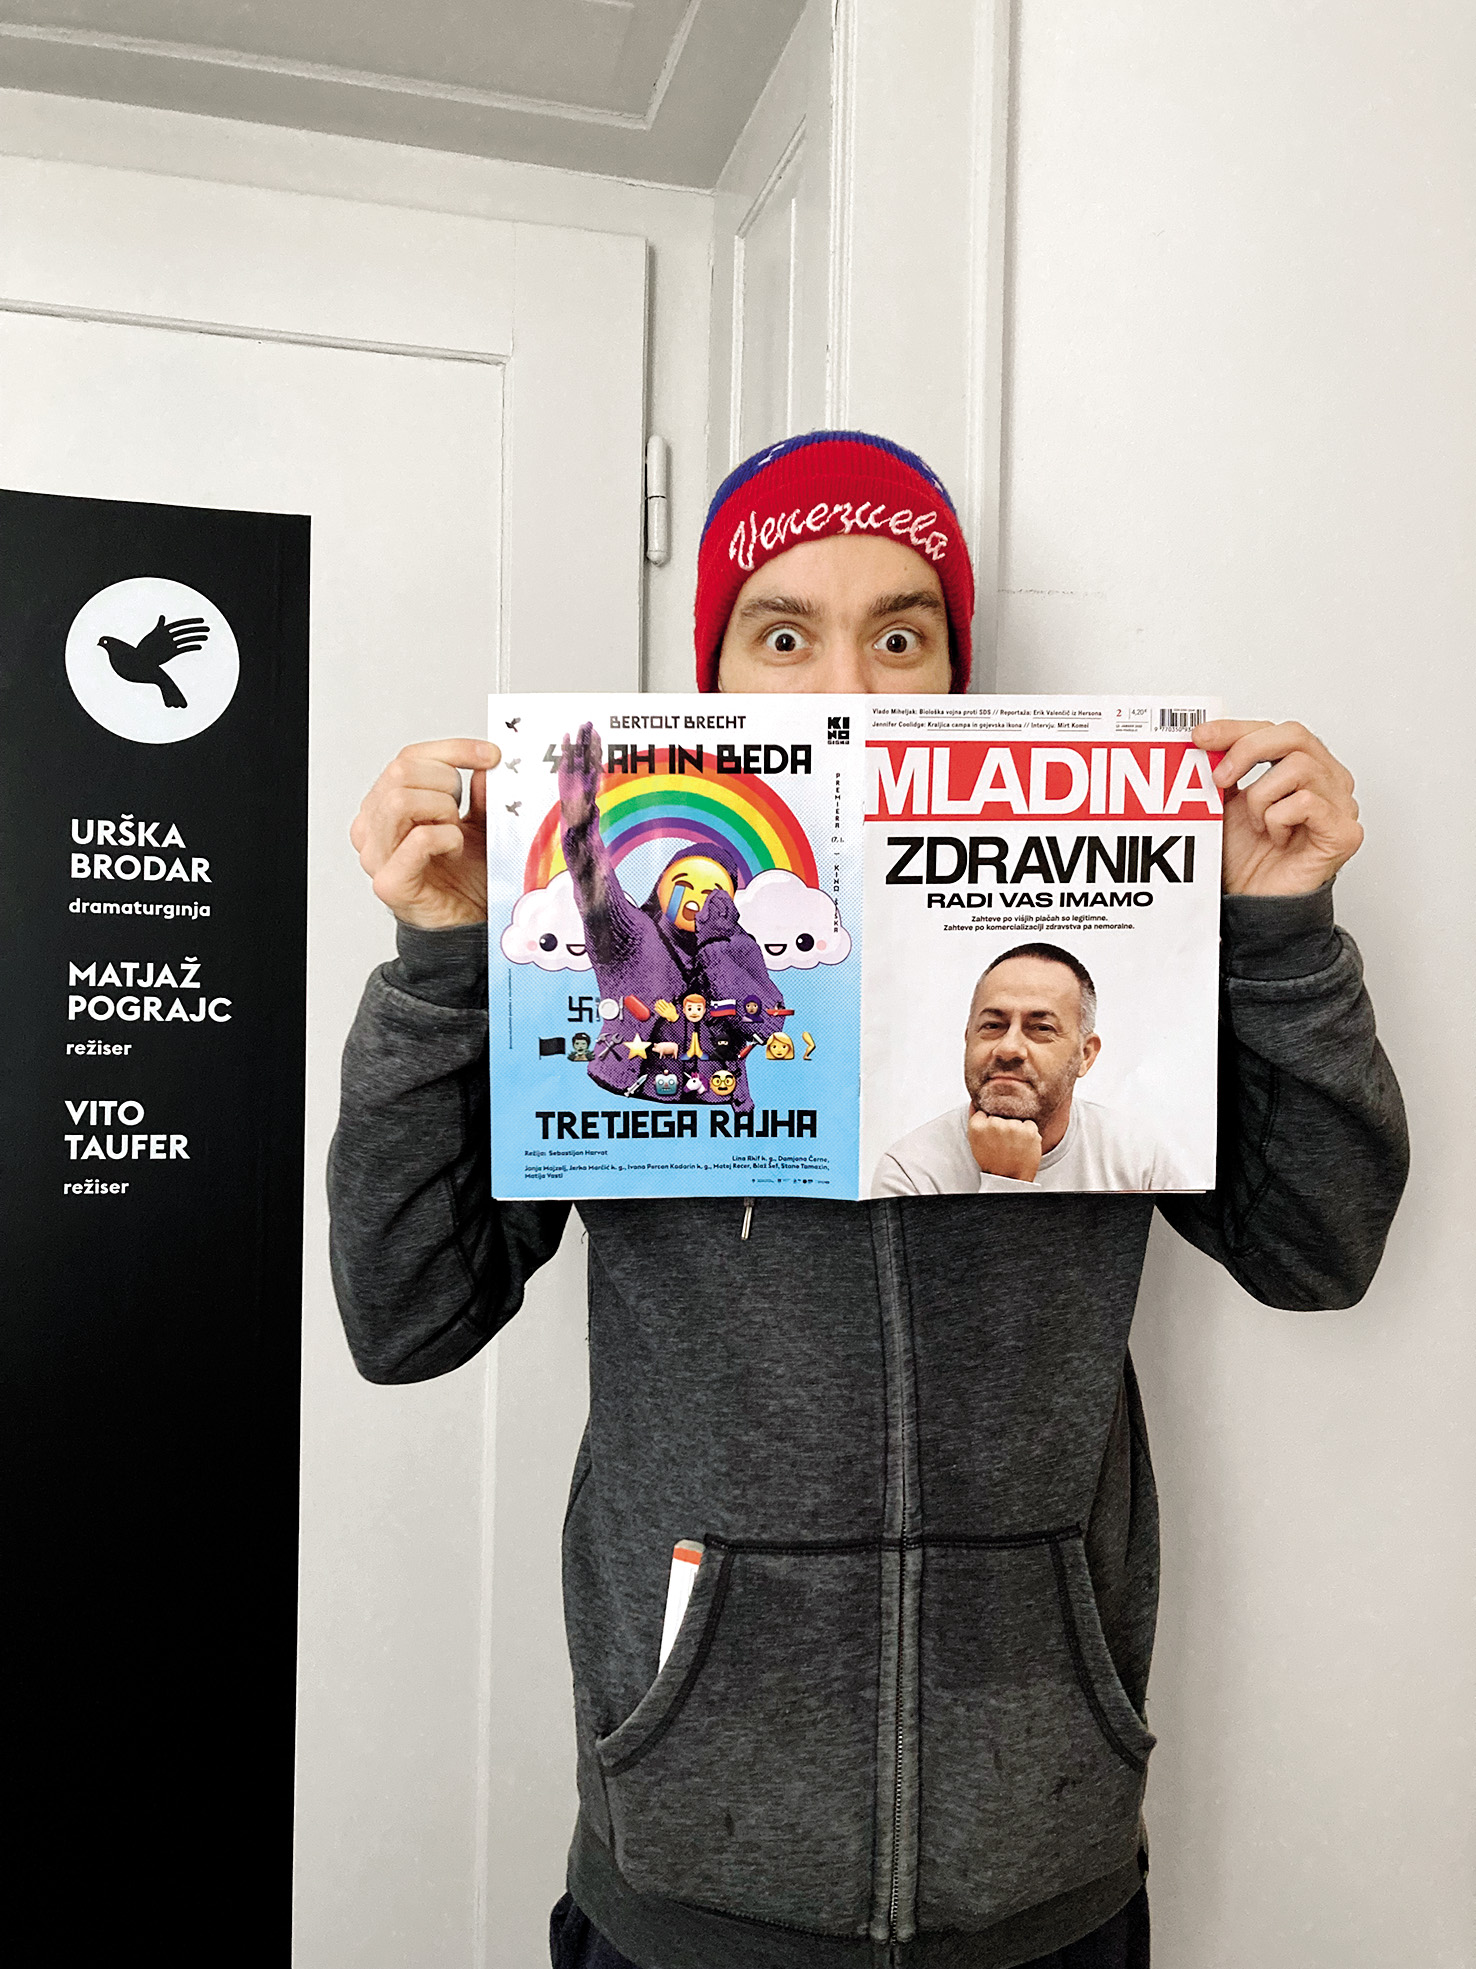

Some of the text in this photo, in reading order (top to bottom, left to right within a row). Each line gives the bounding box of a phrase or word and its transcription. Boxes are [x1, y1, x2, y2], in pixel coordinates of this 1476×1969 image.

[728, 501, 948, 571] Venezuela
[609, 715, 747, 729] BERTOLT BRECHT
[899, 721, 926, 729] Coolidge:
[927, 721, 950, 729] Kraljica
[946, 709, 961, 717] vojna
[963, 709, 978, 717] proti
[1116, 708, 1122, 717] 2
[668, 744, 704, 774] IN
[716, 744, 812, 774] BEDA
[865, 747, 1223, 815] MLADINA
[71, 813, 186, 848] URŠKA
[70, 852, 212, 883] BRODAR
[885, 836, 1195, 884] ZDRAVNIKI
[927, 891, 1154, 908] RADI VAS IMAMO
[986, 924, 1045, 932] komercializaciji
[1014, 915, 1034, 923] višjih
[1035, 914, 1060, 922] plačah
[1071, 915, 1108, 923] legitimne.
[68, 956, 201, 989] MATJAŽ
[68, 994, 232, 1023] POGRAJC
[65, 1039, 132, 1056] režiser
[64, 1100, 145, 1126] VITO
[535, 1109, 817, 1140] TRETJEGA RAJHA
[64, 1134, 191, 1160] TAUFER
[63, 1178, 130, 1195] režiser
